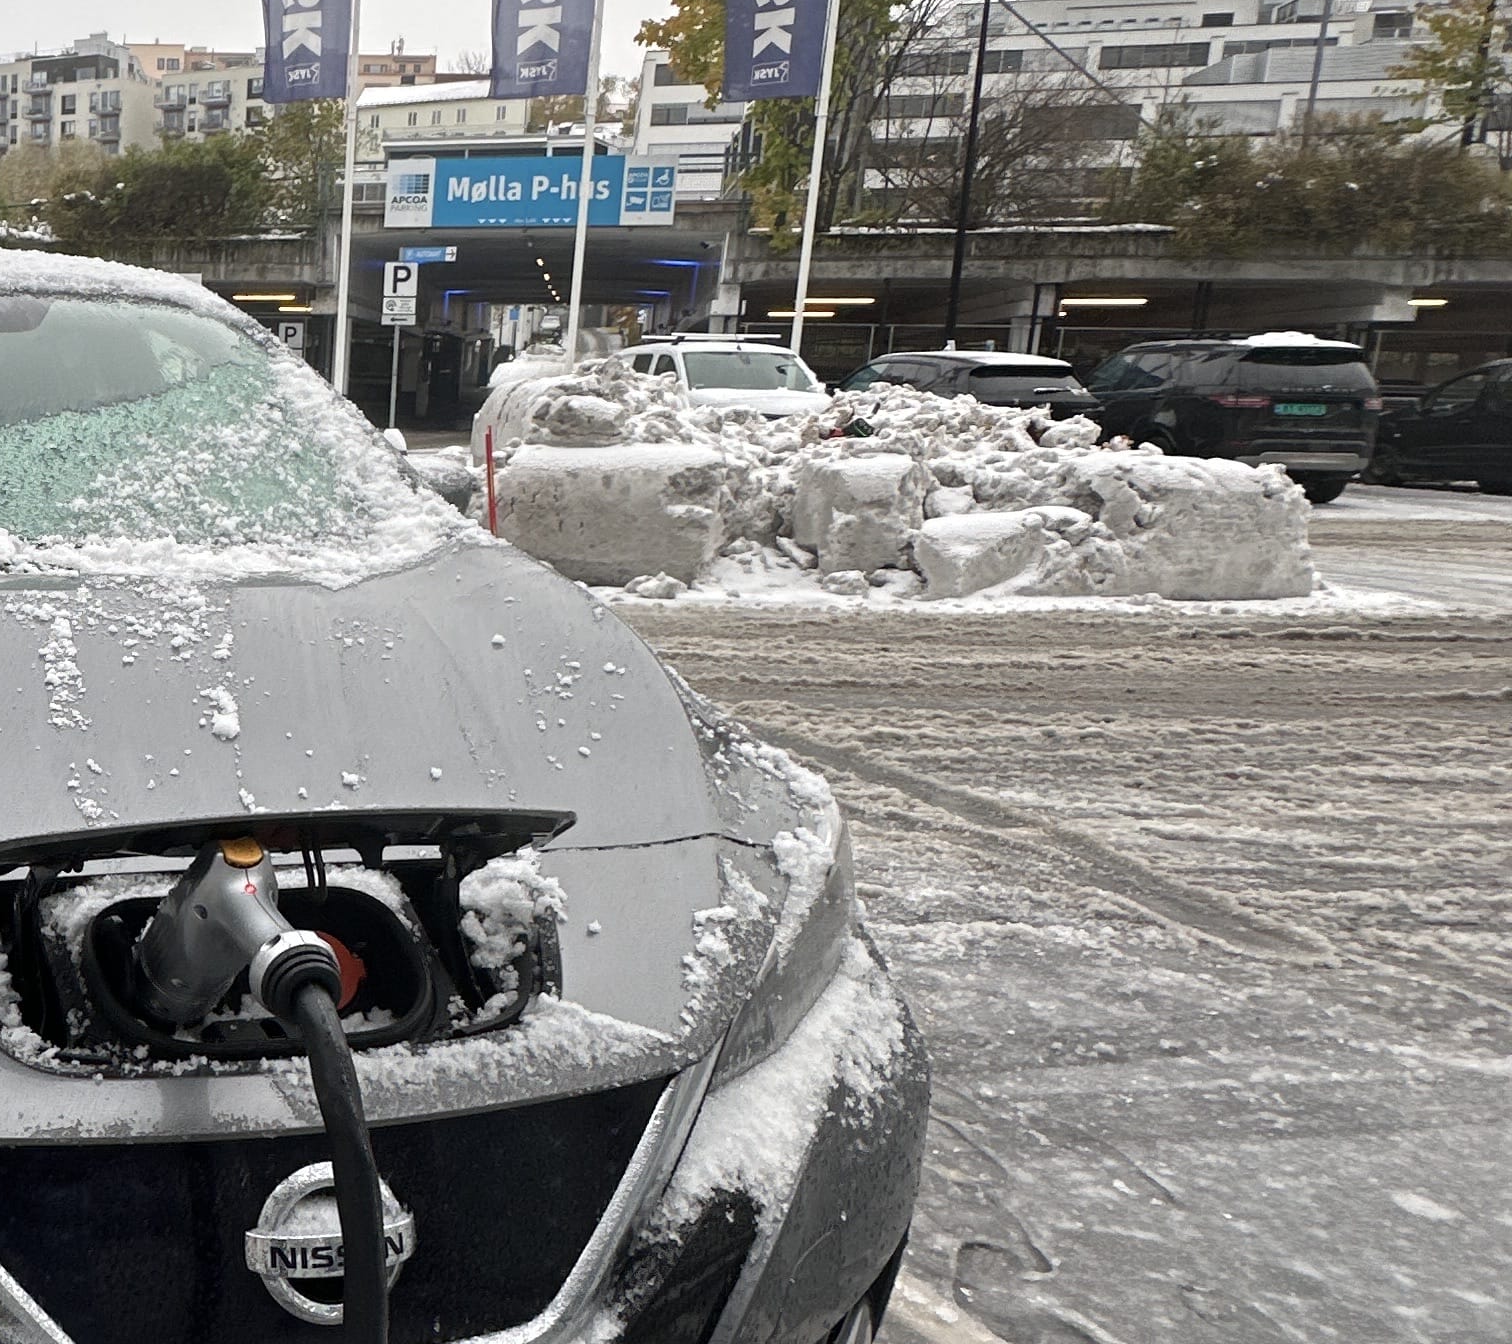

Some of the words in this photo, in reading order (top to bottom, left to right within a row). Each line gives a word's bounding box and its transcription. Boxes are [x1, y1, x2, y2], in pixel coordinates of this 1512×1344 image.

[391, 195, 428, 204] APCOA
[447, 174, 521, 204] Mølla
[392, 265, 412, 294] P
[285, 326, 297, 344] P
[270, 1232, 404, 1269] NISN
